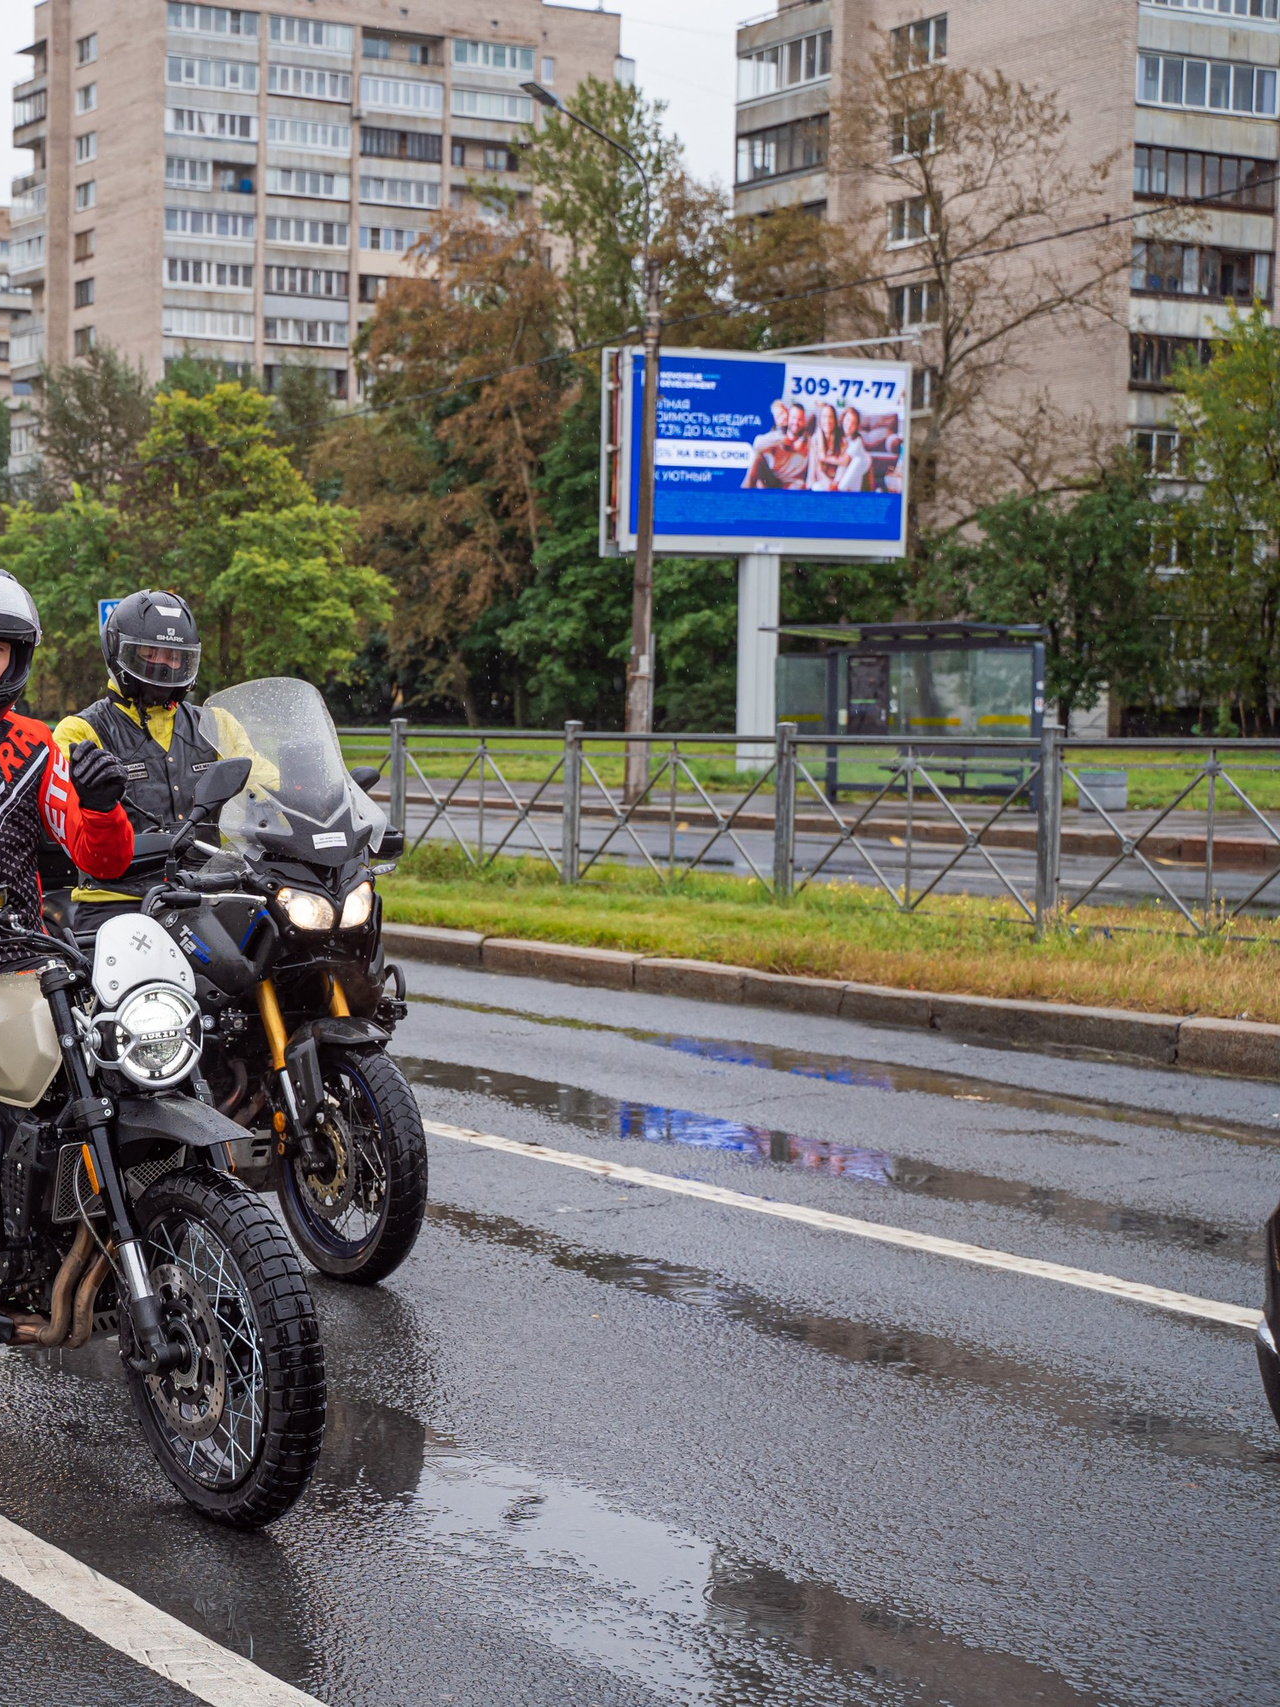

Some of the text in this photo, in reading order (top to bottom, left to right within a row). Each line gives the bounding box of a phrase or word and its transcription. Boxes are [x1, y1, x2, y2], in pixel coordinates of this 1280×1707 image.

[791, 376, 896, 399] 309-77-77
[712, 413, 762, 427] КРЕДИТА
[683, 425, 700, 437] ДО
[676, 448, 691, 458] НА
[694, 449, 719, 459] ВЕСЬ
[661, 469, 712, 482] УЮТНЫЙ
[156, 634, 184, 643] SHARK
